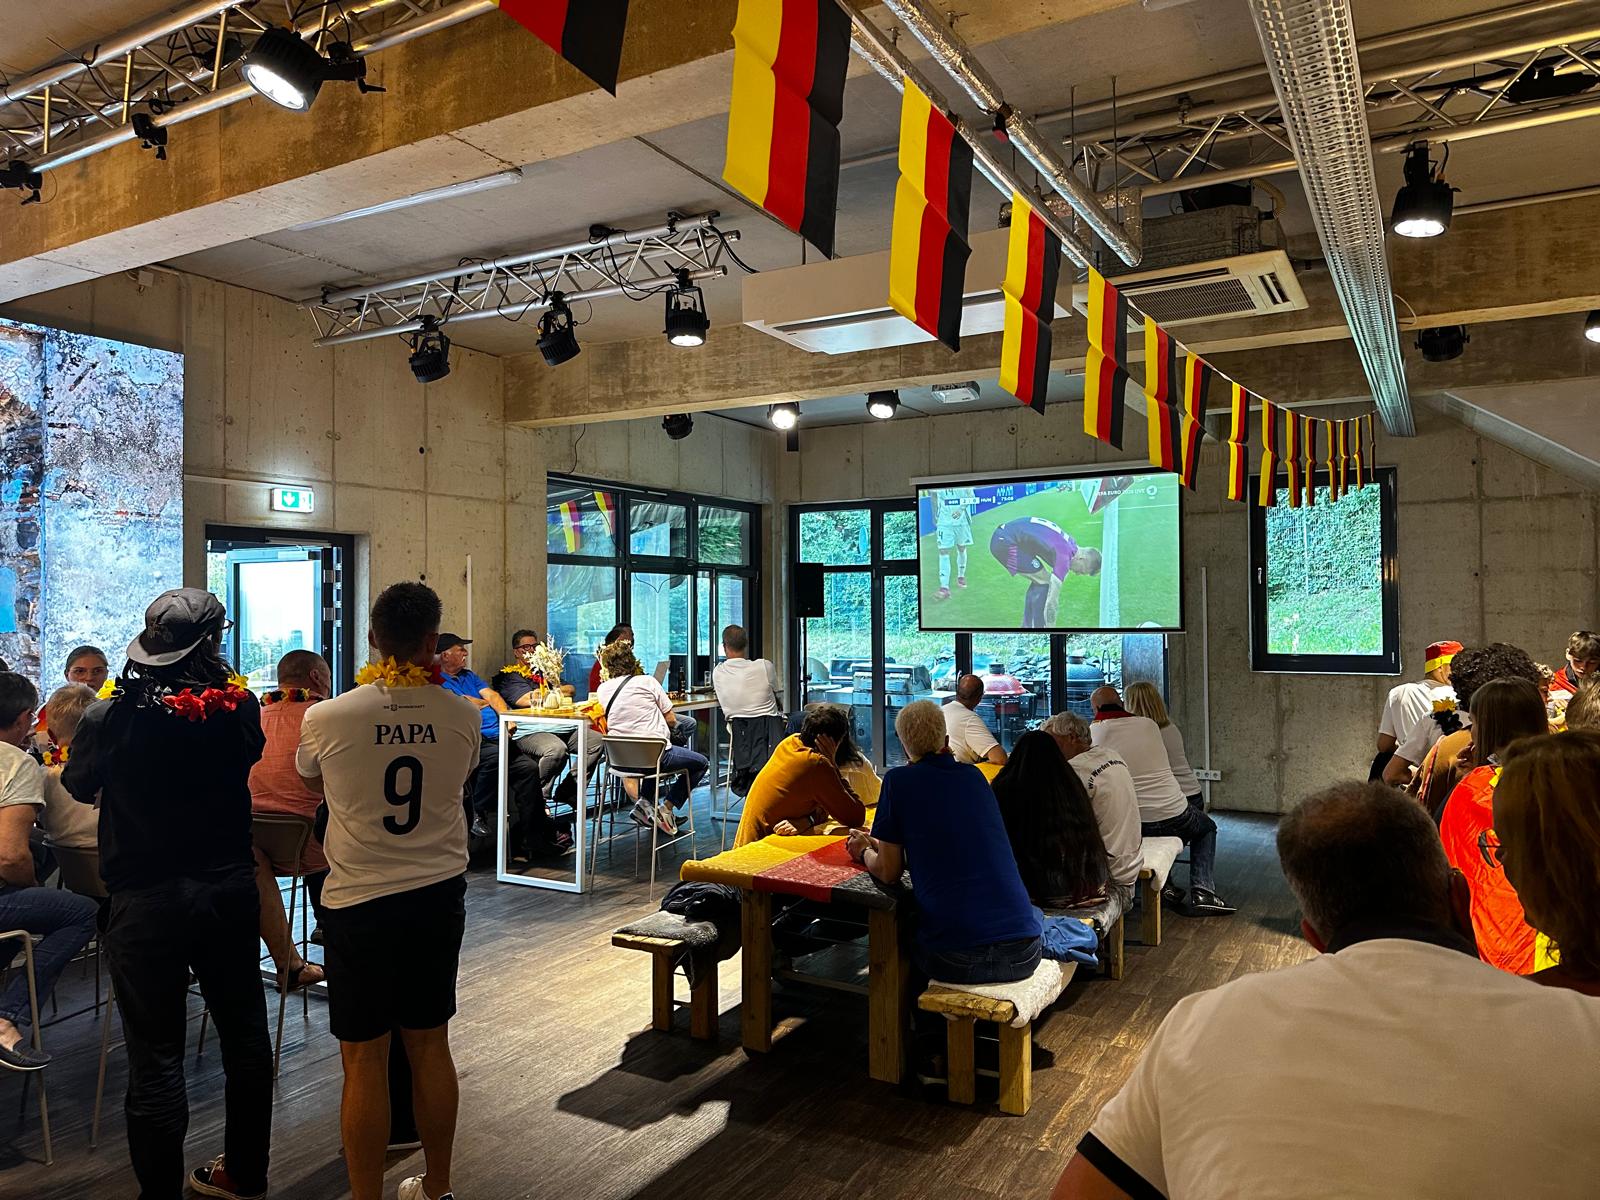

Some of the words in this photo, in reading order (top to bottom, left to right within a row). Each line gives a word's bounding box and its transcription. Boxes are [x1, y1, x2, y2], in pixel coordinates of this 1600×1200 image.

[374, 723, 438, 745] PAPA
[1091, 762, 1111, 777] Werden
[382, 755, 424, 836] 9
